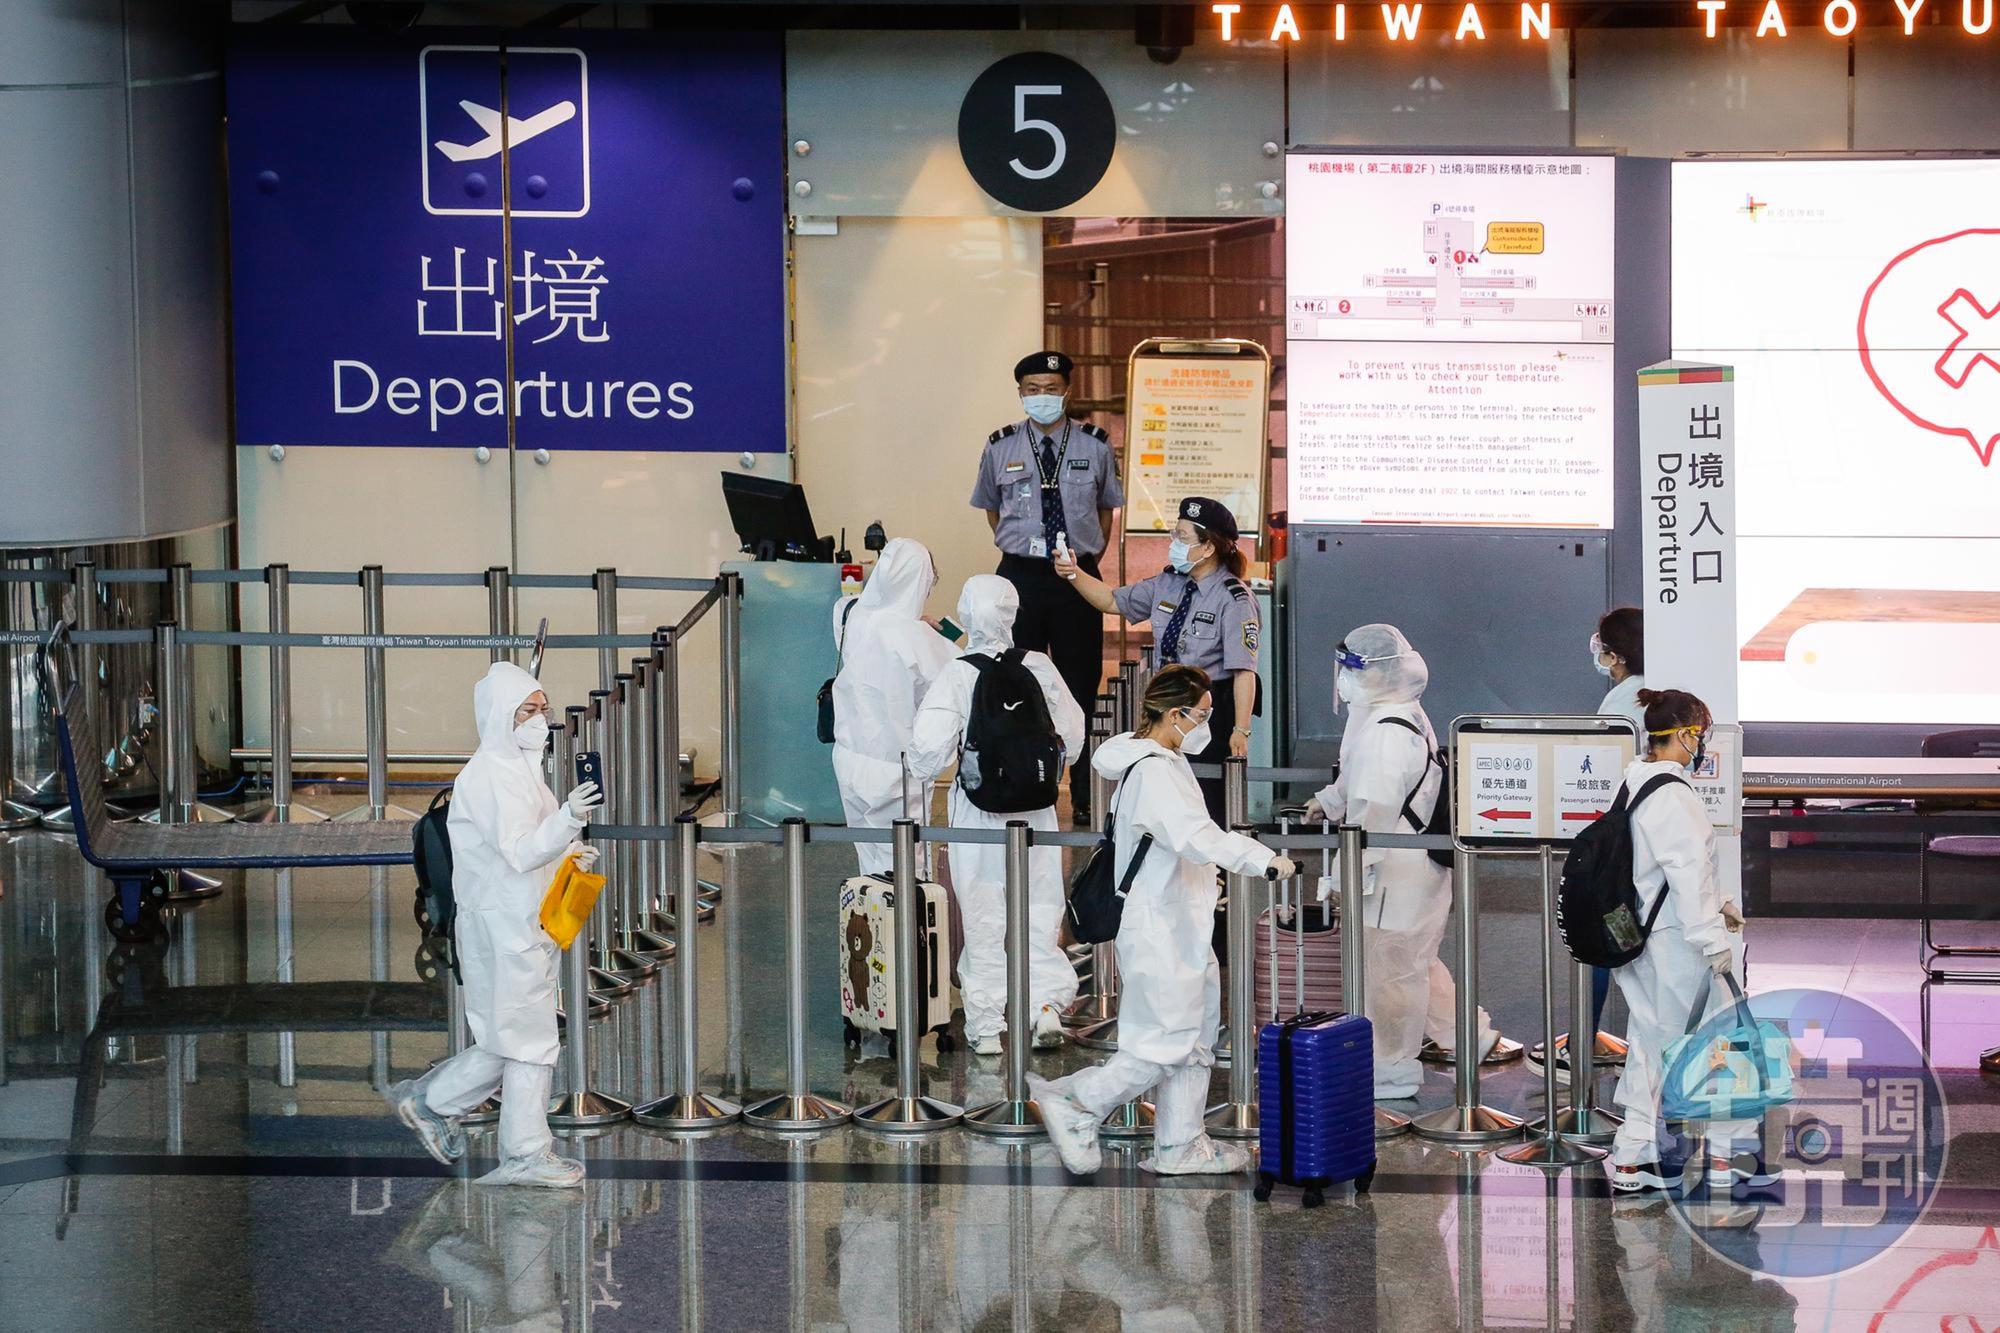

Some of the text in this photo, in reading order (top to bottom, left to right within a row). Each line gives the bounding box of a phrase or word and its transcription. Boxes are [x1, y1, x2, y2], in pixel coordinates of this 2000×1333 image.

[1212, 2, 1551, 41] TAIWAN
[1009, 85, 1067, 180] 5
[416, 246, 610, 344] 出境
[1348, 361, 1557, 374] To prevent virus transmission please
[1339, 371, 1363, 380] work
[1368, 371, 1392, 380] with
[1415, 372, 1427, 381] to
[1433, 372, 1462, 381] check
[1468, 374, 1491, 383] your
[1497, 373, 1565, 384] temperature.
[334, 360, 694, 432] Departures
[1428, 385, 1481, 395] Attention
[1688, 404, 1725, 585] 出境入口
[1651, 453, 1683, 605] Departure
[11, 633, 41, 643] Airport
[394, 636, 423, 646] Taiwan
[425, 637, 460, 648] Taoyuan
[461, 637, 512, 647] International
[1482, 778, 1527, 790] 優先通道
[1565, 779, 1611, 791] 一般旅客
[1768, 775, 1805, 787] Taoyuan
[1808, 776, 1867, 786] International
[1868, 776, 1902, 788] Airport
[1477, 793, 1533, 803] Priority Gateway
[1560, 796, 1590, 805] Passenger
